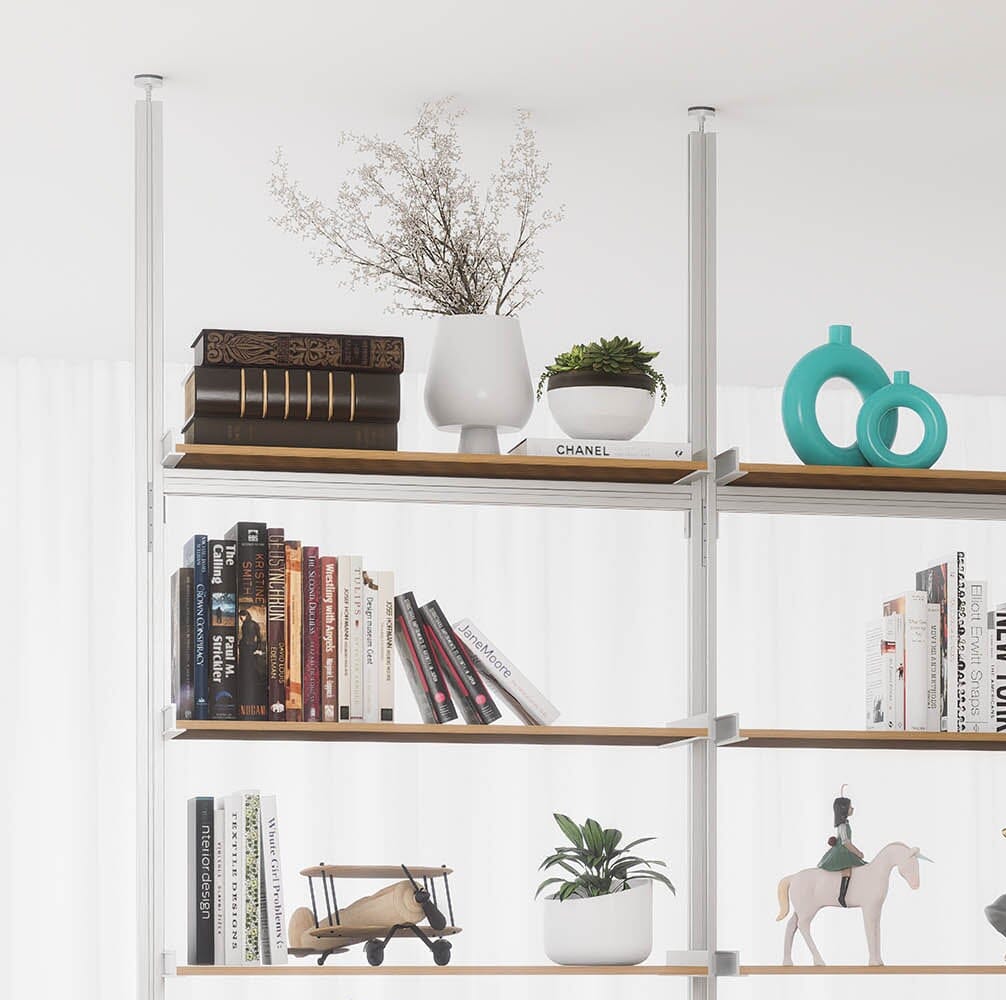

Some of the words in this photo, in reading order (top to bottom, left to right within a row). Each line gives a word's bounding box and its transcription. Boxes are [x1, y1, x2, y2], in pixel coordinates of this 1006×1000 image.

[556, 444, 610, 456] CHANEL
[211, 544, 223, 585] Calling
[225, 544, 236, 566] The
[308, 554, 317, 568] THE
[242, 561, 253, 597] SMITH
[254, 552, 264, 604] KRISTINE
[308, 570, 317, 600] SECOND
[323, 563, 336, 603] Wrestling
[353, 568, 361, 616] TULIPS
[196, 584, 206, 616] CROWN
[323, 605, 336, 624] with
[970, 584, 983, 621] Elliott
[308, 601, 317, 635] DUCHESS
[196, 616, 206, 667] CONSPIRACY
[225, 635, 236, 661] Paul
[323, 625, 336, 652] Angels
[970, 626, 983, 665] Erwitt
[212, 635, 223, 684] Strickler
[225, 663, 236, 678] M.
[270, 646, 278, 680] EDELMAN
[969, 670, 983, 716] Snaps
